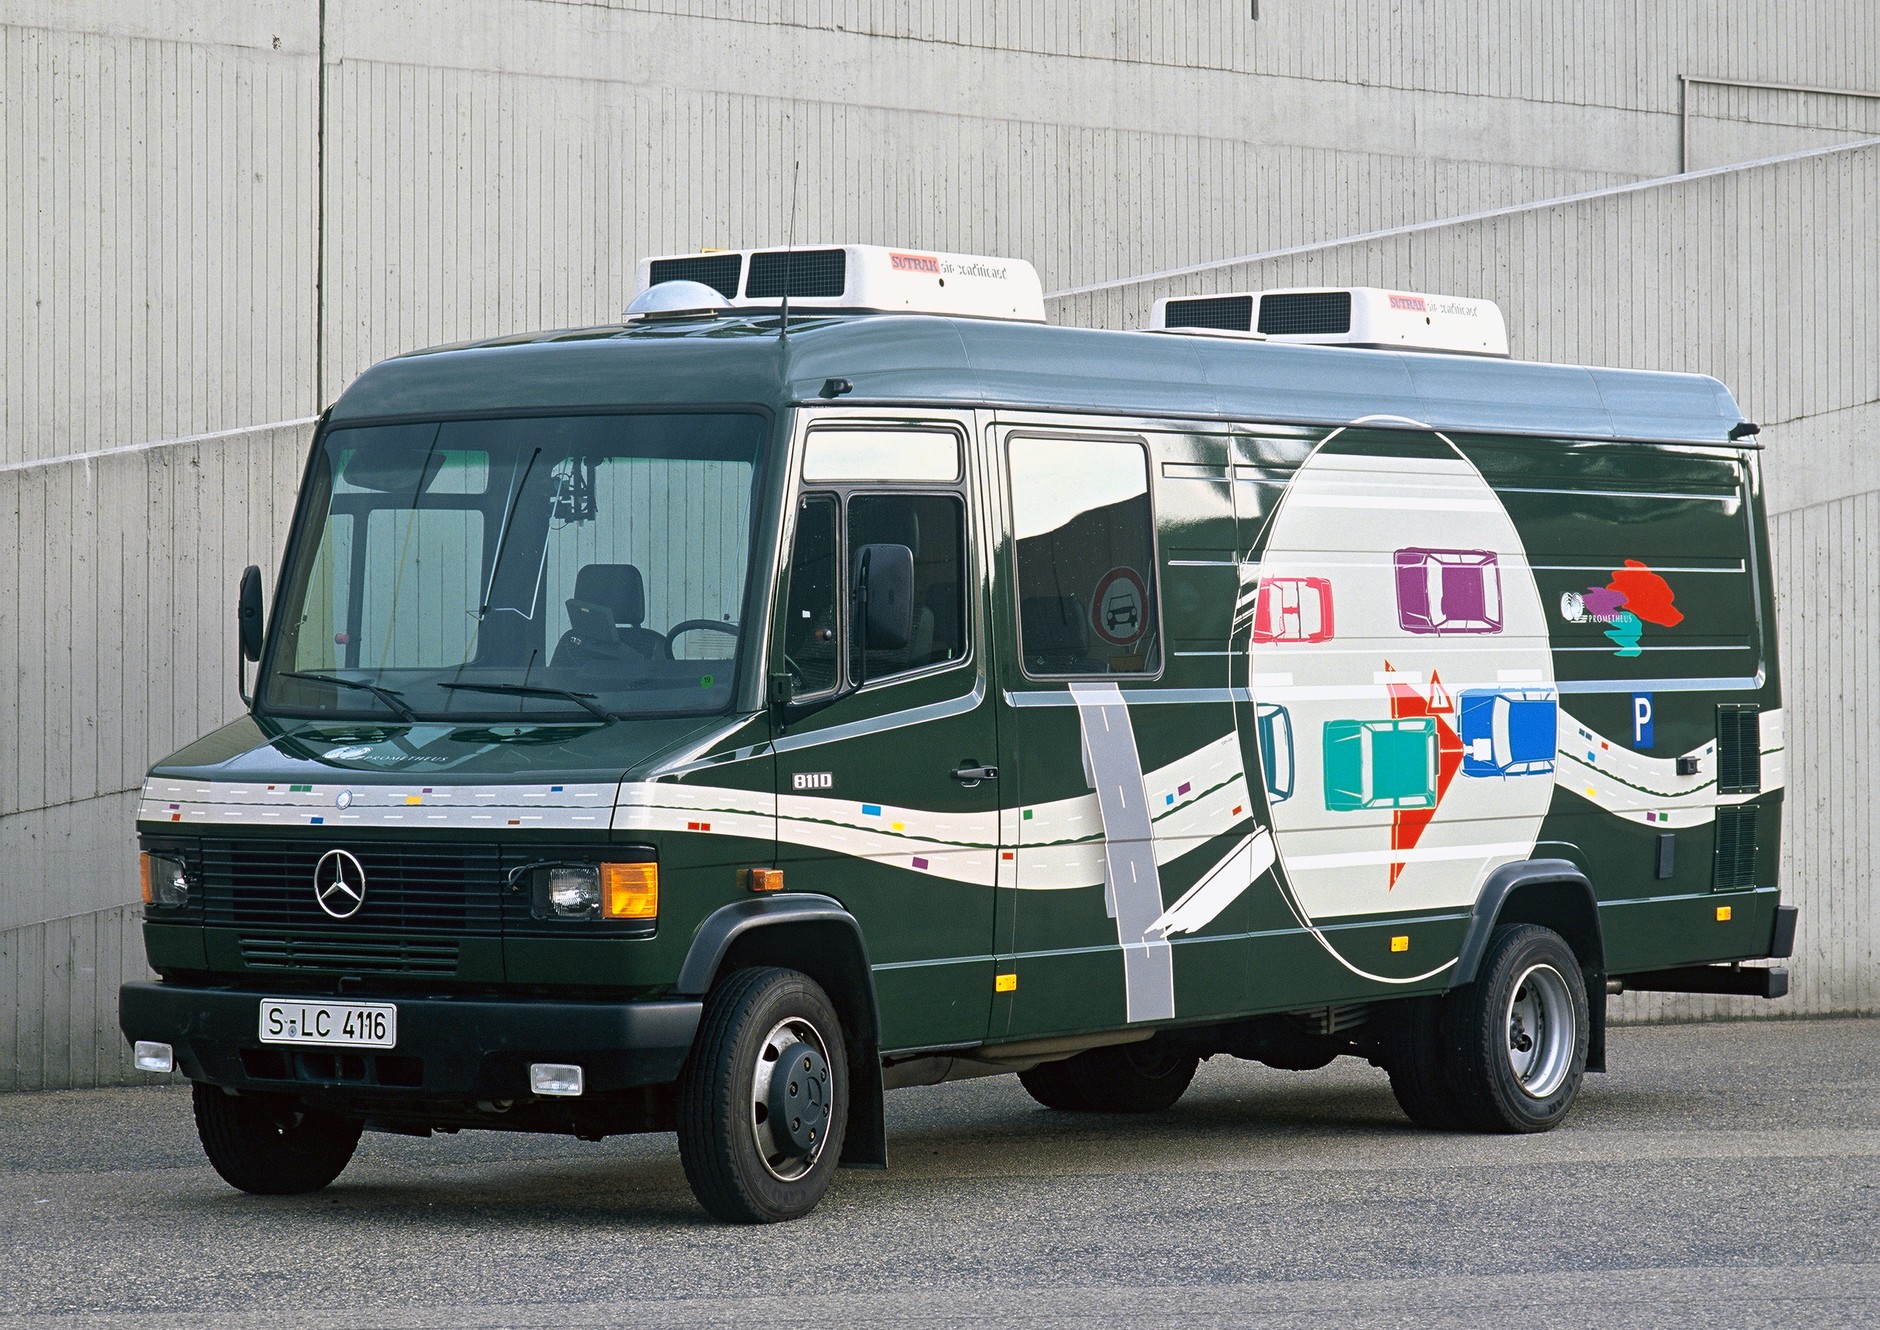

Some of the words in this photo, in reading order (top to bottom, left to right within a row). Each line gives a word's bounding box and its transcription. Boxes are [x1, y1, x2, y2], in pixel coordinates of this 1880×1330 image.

[891, 256, 939, 273] SUTRAK
[1389, 297, 1426, 312] SUTRAK
[1588, 614, 1633, 623] PROMETHEUS
[1635, 697, 1651, 741] P
[342, 1010, 386, 1040] 4116
